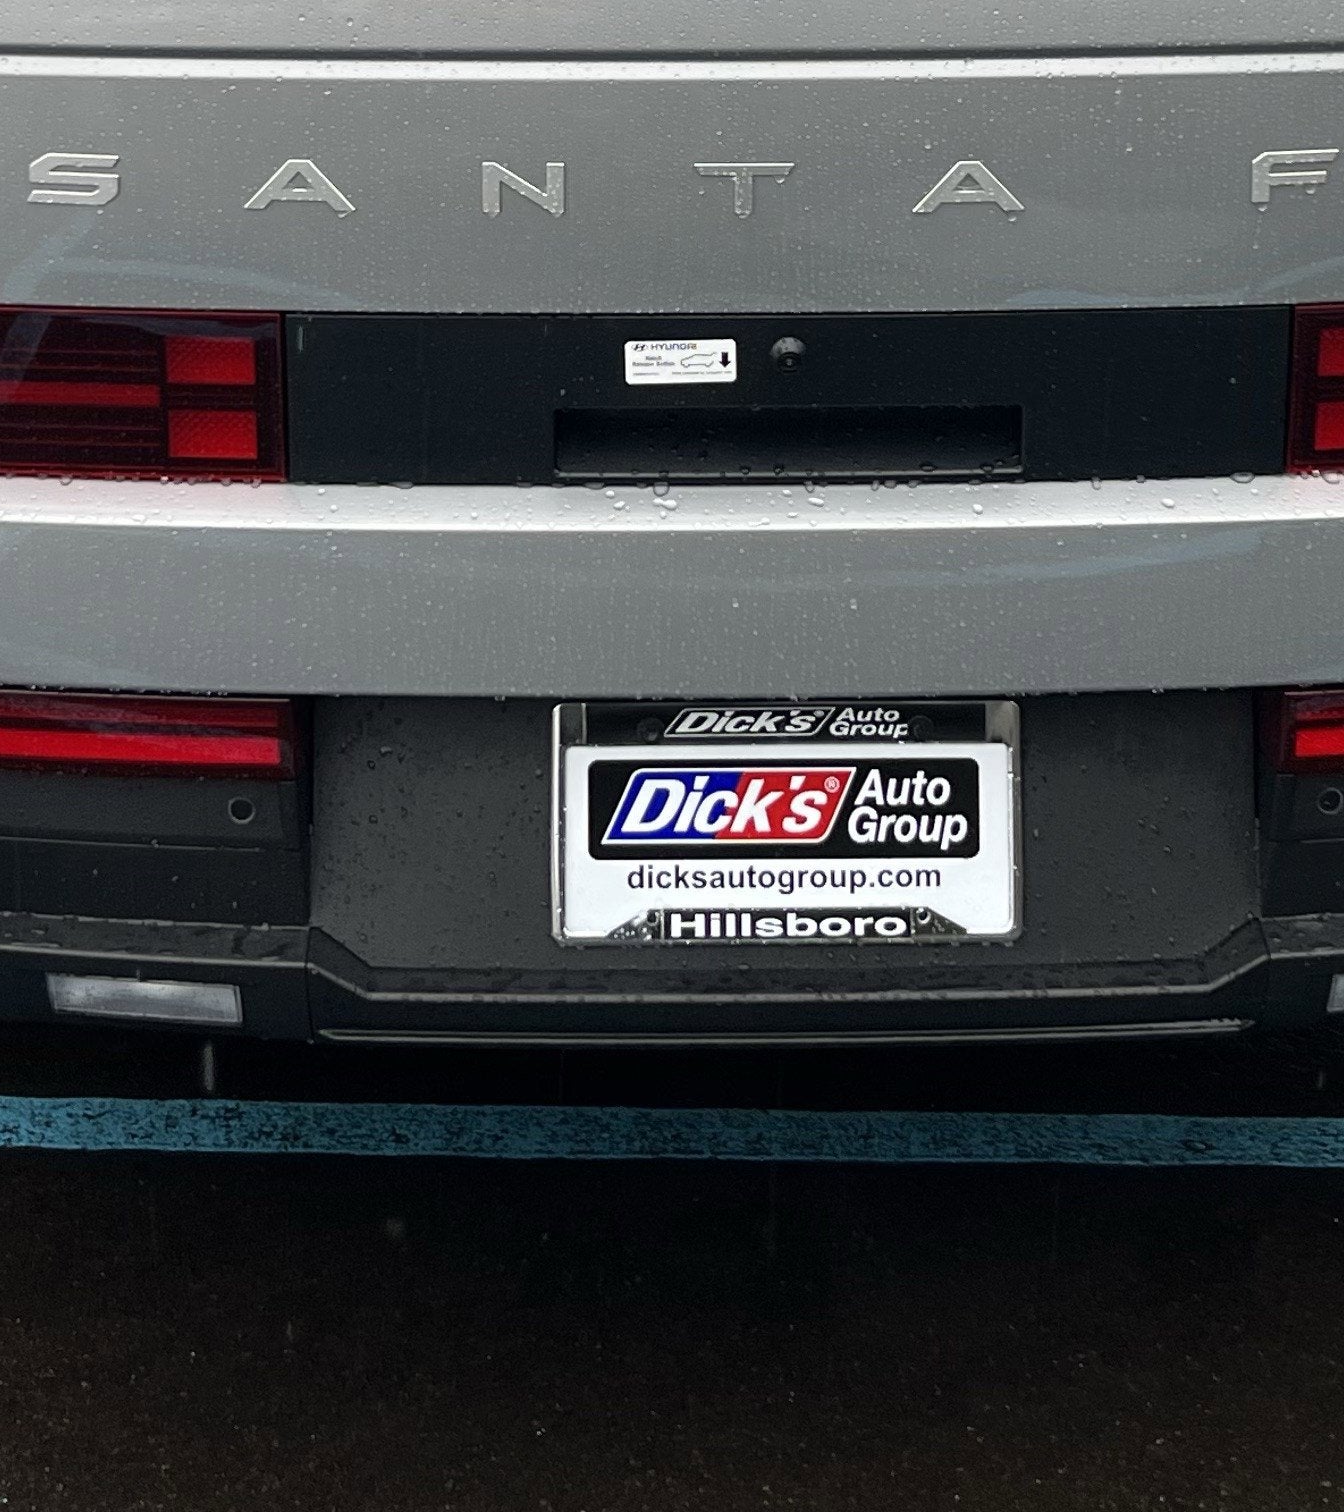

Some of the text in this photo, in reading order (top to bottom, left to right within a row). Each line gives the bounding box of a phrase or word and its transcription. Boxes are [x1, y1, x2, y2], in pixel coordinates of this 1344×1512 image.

[27, 152, 1025, 217] SANTA
[675, 707, 900, 734] Dick's Auto
[829, 721, 908, 739] Group
[621, 769, 951, 834] Dick's Auto
[847, 808, 968, 851] Group
[627, 864, 941, 894] dicksautogroup.com
[670, 913, 907, 939] Hillsboro
